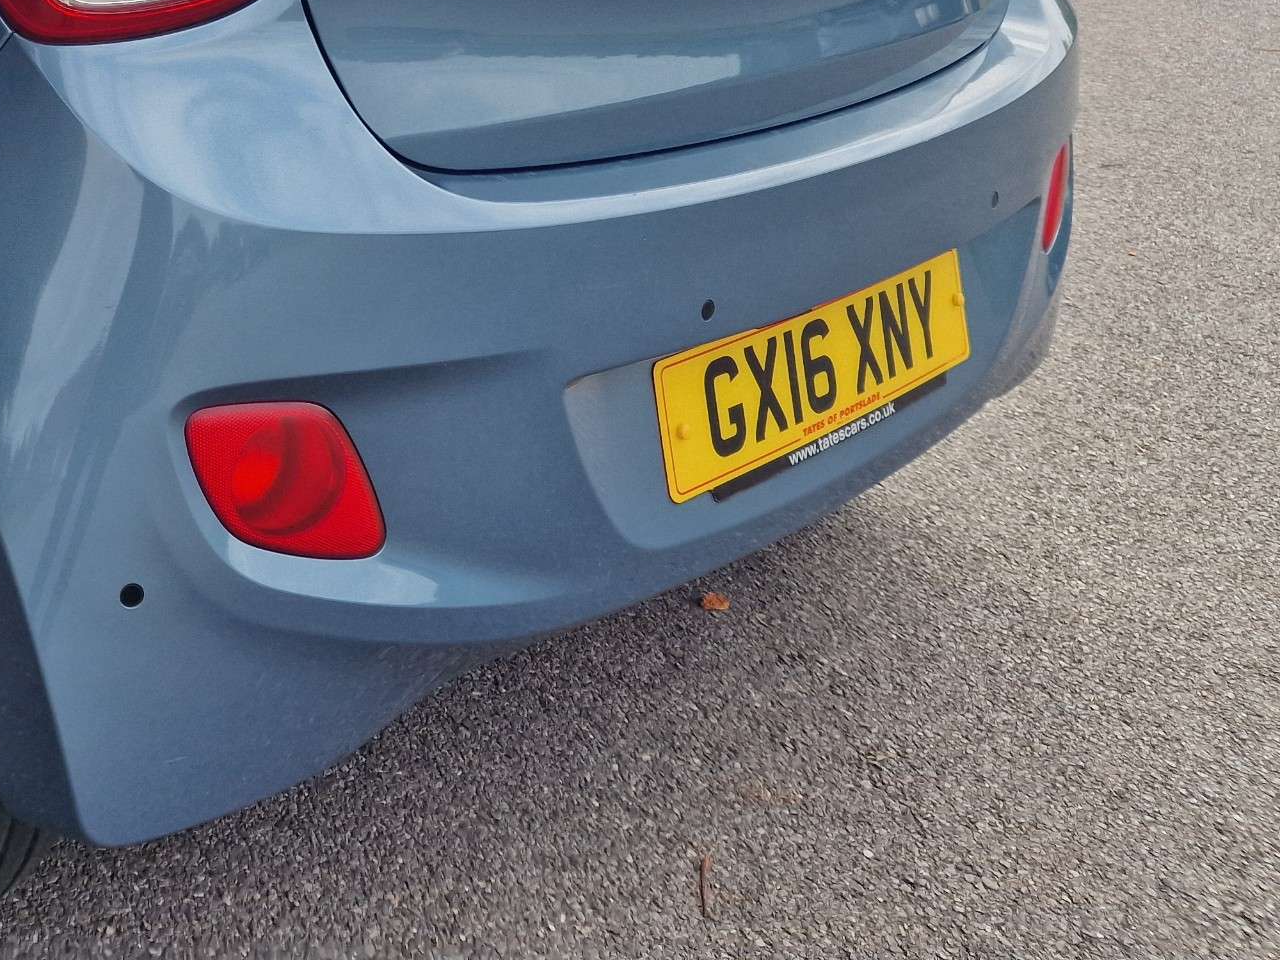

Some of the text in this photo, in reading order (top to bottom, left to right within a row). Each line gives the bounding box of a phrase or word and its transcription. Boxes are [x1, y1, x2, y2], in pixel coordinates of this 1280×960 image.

[703, 270, 934, 459] GX16 XNY
[788, 401, 896, 466] www.tatescars.co.uk
[802, 419, 826, 436] TATES
[827, 413, 838, 425] OF
